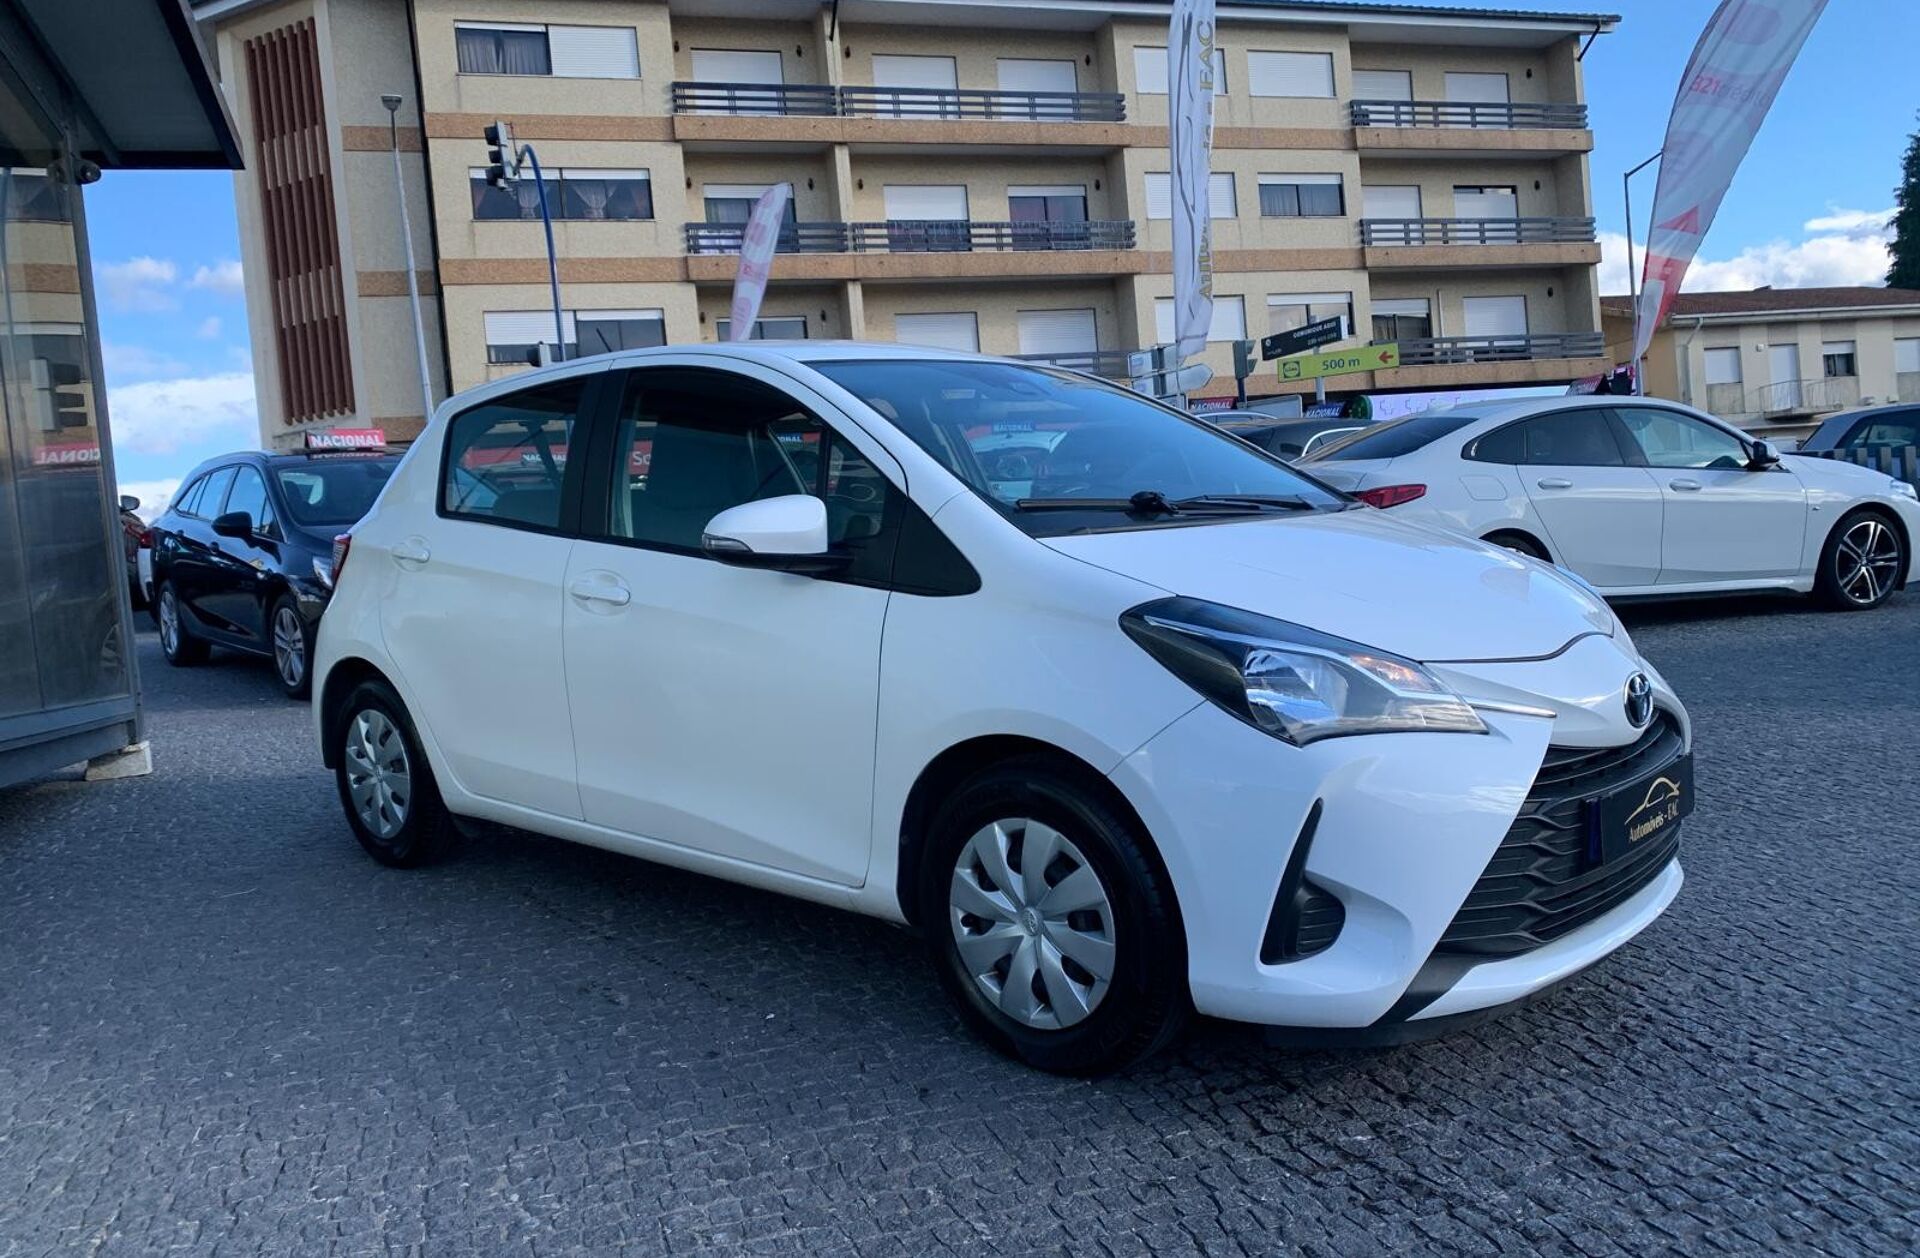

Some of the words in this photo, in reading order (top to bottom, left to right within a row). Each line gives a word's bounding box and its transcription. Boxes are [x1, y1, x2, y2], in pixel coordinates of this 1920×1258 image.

[1197, 20, 1215, 92] EAC
[1322, 357, 1345, 370] 500
[1348, 357, 1360, 367] m
[1191, 401, 1231, 410] NACIONAL
[1306, 407, 1340, 417] NACIONAL
[310, 434, 386, 448] NACIONAL
